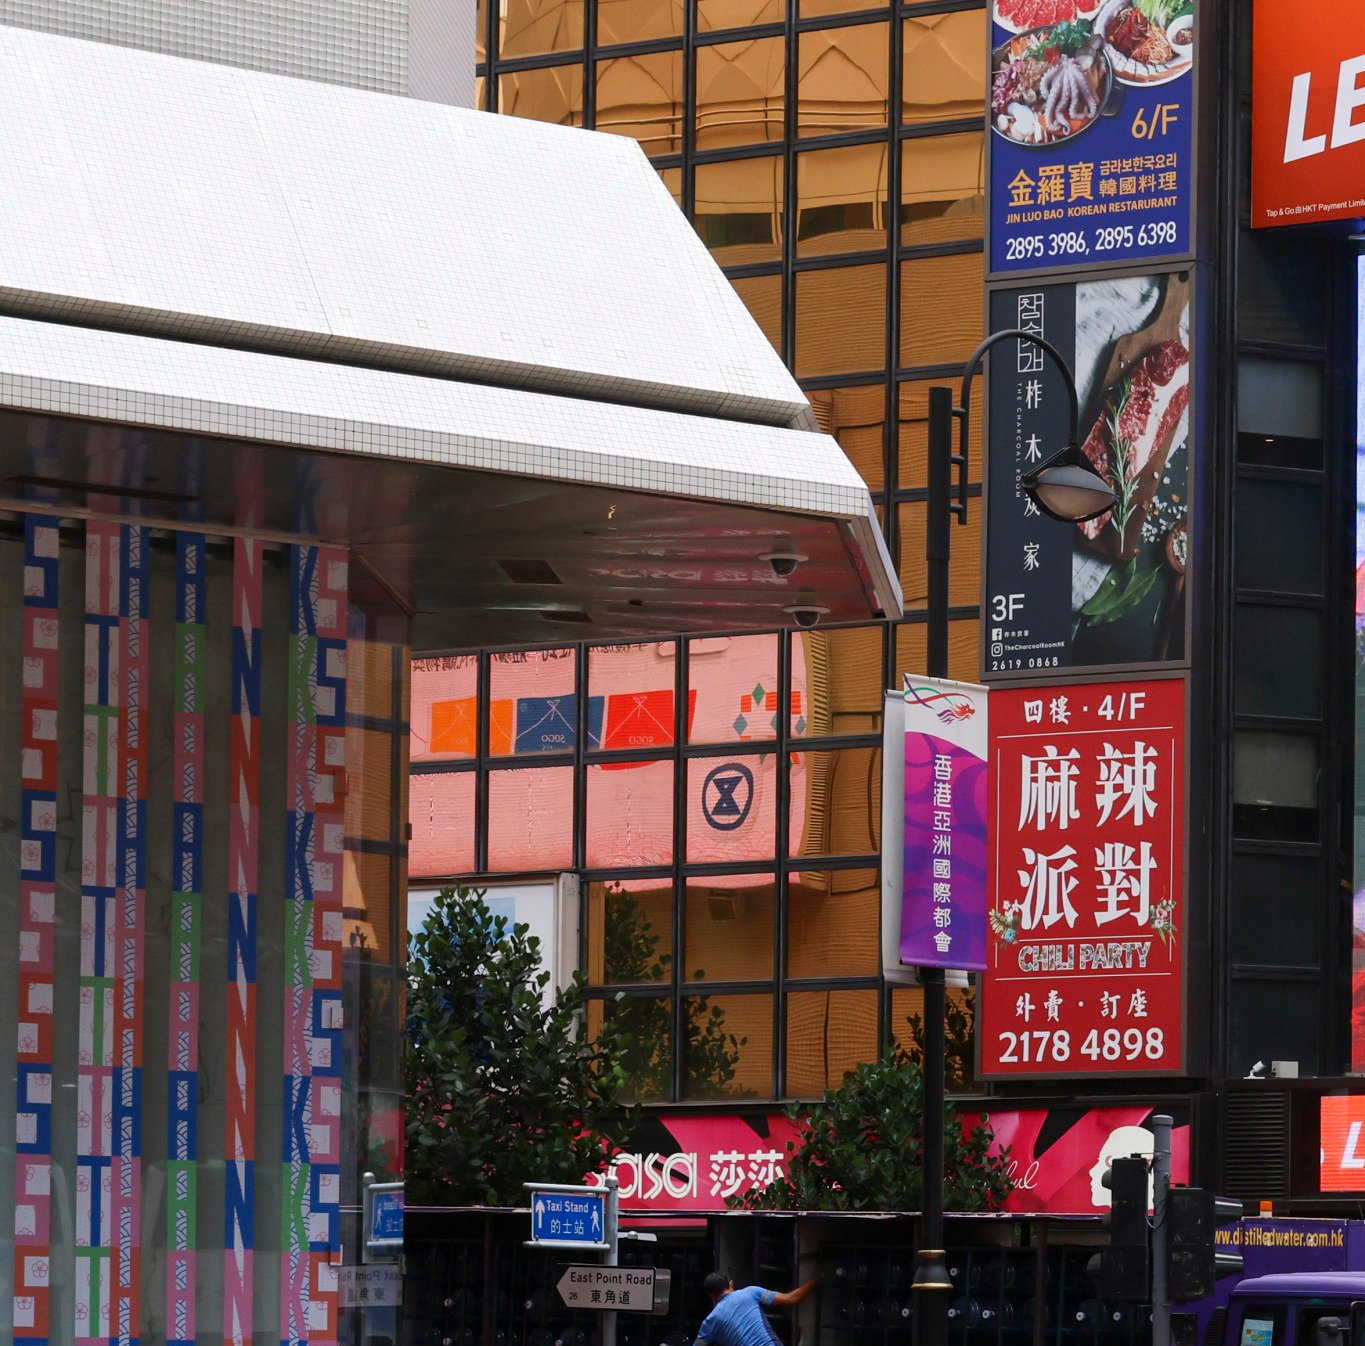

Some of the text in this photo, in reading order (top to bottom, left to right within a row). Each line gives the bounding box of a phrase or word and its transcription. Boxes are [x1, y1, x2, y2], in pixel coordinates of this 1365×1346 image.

[1131, 104, 1179, 140] 6/F
[1007, 161, 1094, 207] 金羅寶
[1099, 171, 1177, 198] 韓國料理
[1006, 209, 1020, 224] JIN
[1022, 207, 1041, 222] LUO
[1043, 206, 1064, 221] BAO
[1067, 202, 1107, 219] KOREAN
[1266, 209, 1278, 218] Tap
[1318, 202, 1347, 212] Payment
[1006, 234, 1044, 260] 2895
[1095, 225, 1133, 250] 2895
[1137, 221, 1177, 246] 6398
[991, 593, 1025, 622] 3F
[1004, 641, 1066, 652] TheCharcoalRoomHK
[992, 656, 1060, 671] 2619 0868
[1023, 691, 1147, 726] 四樓 4/F
[1018, 741, 1158, 832] 麻辣
[933, 753, 952, 953] 香港亞洲國際都會
[1017, 841, 1157, 931] 派對
[1018, 940, 1151, 973] CHILI PARTY
[999, 1027, 1164, 1062] 2178 4898
[592, 1151, 698, 1200] asa
[547, 1200, 589, 1213] Taxi Stand
[550, 1218, 585, 1236] 的士站
[1215, 1227, 1343, 1247] ww.distilledwater.com.hk
[570, 1272, 652, 1286] East Point Road
[569, 1289, 631, 1306] 26 東角道
